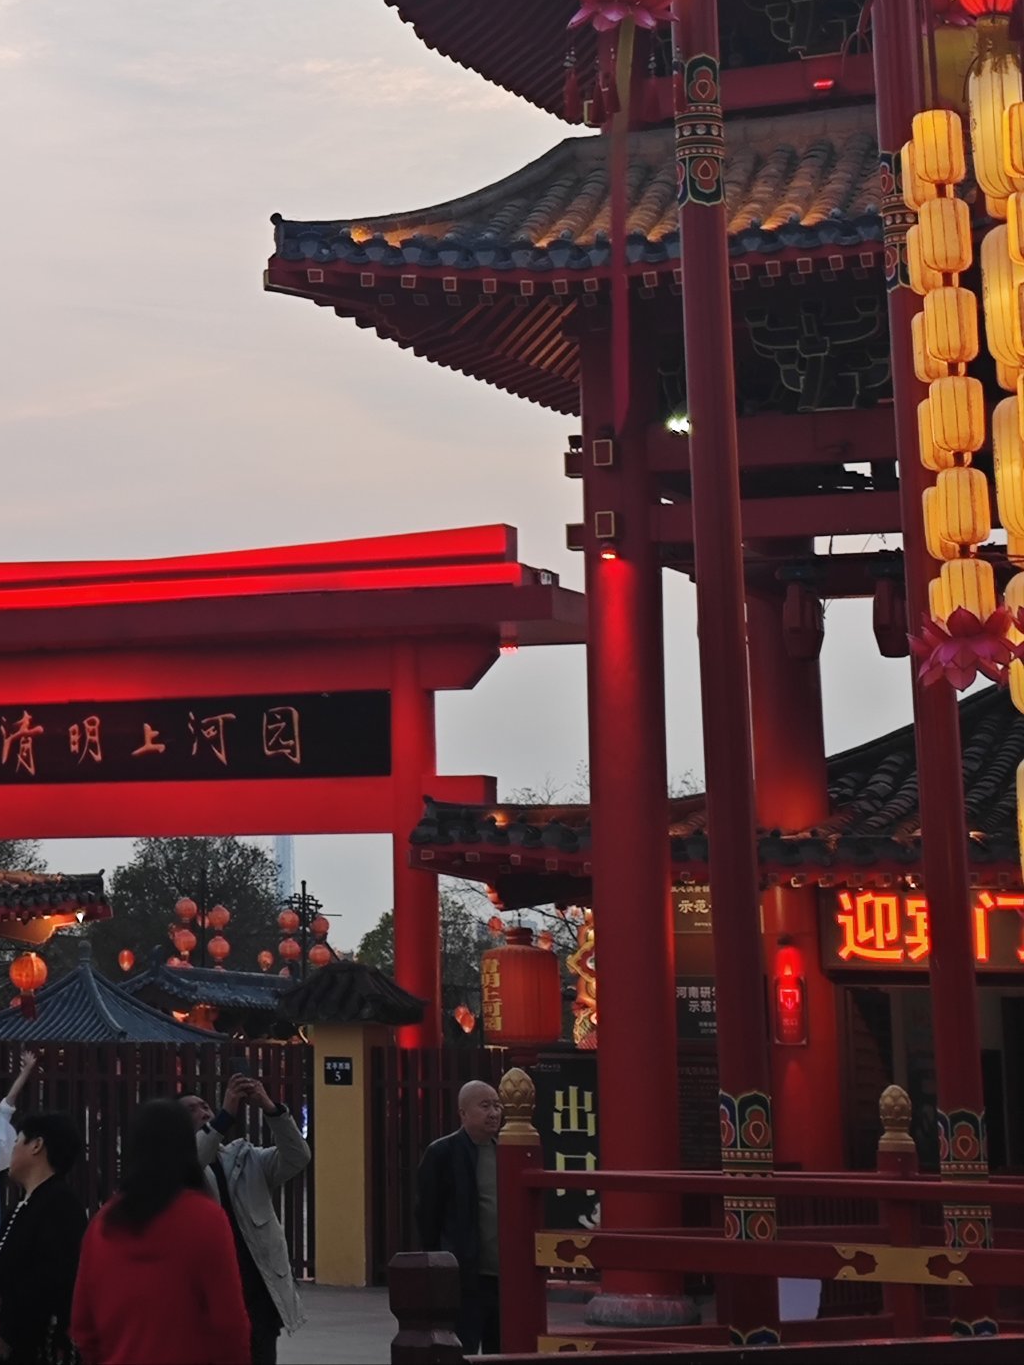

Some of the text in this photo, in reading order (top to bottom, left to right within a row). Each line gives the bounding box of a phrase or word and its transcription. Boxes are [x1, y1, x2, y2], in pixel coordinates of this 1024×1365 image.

[0, 706, 301, 776] 清明上河园
[678, 899, 712, 914] 示范
[688, 1000, 717, 1013] 示范
[334, 1071, 342, 1082] 5
[552, 1085, 597, 1197] 出口
